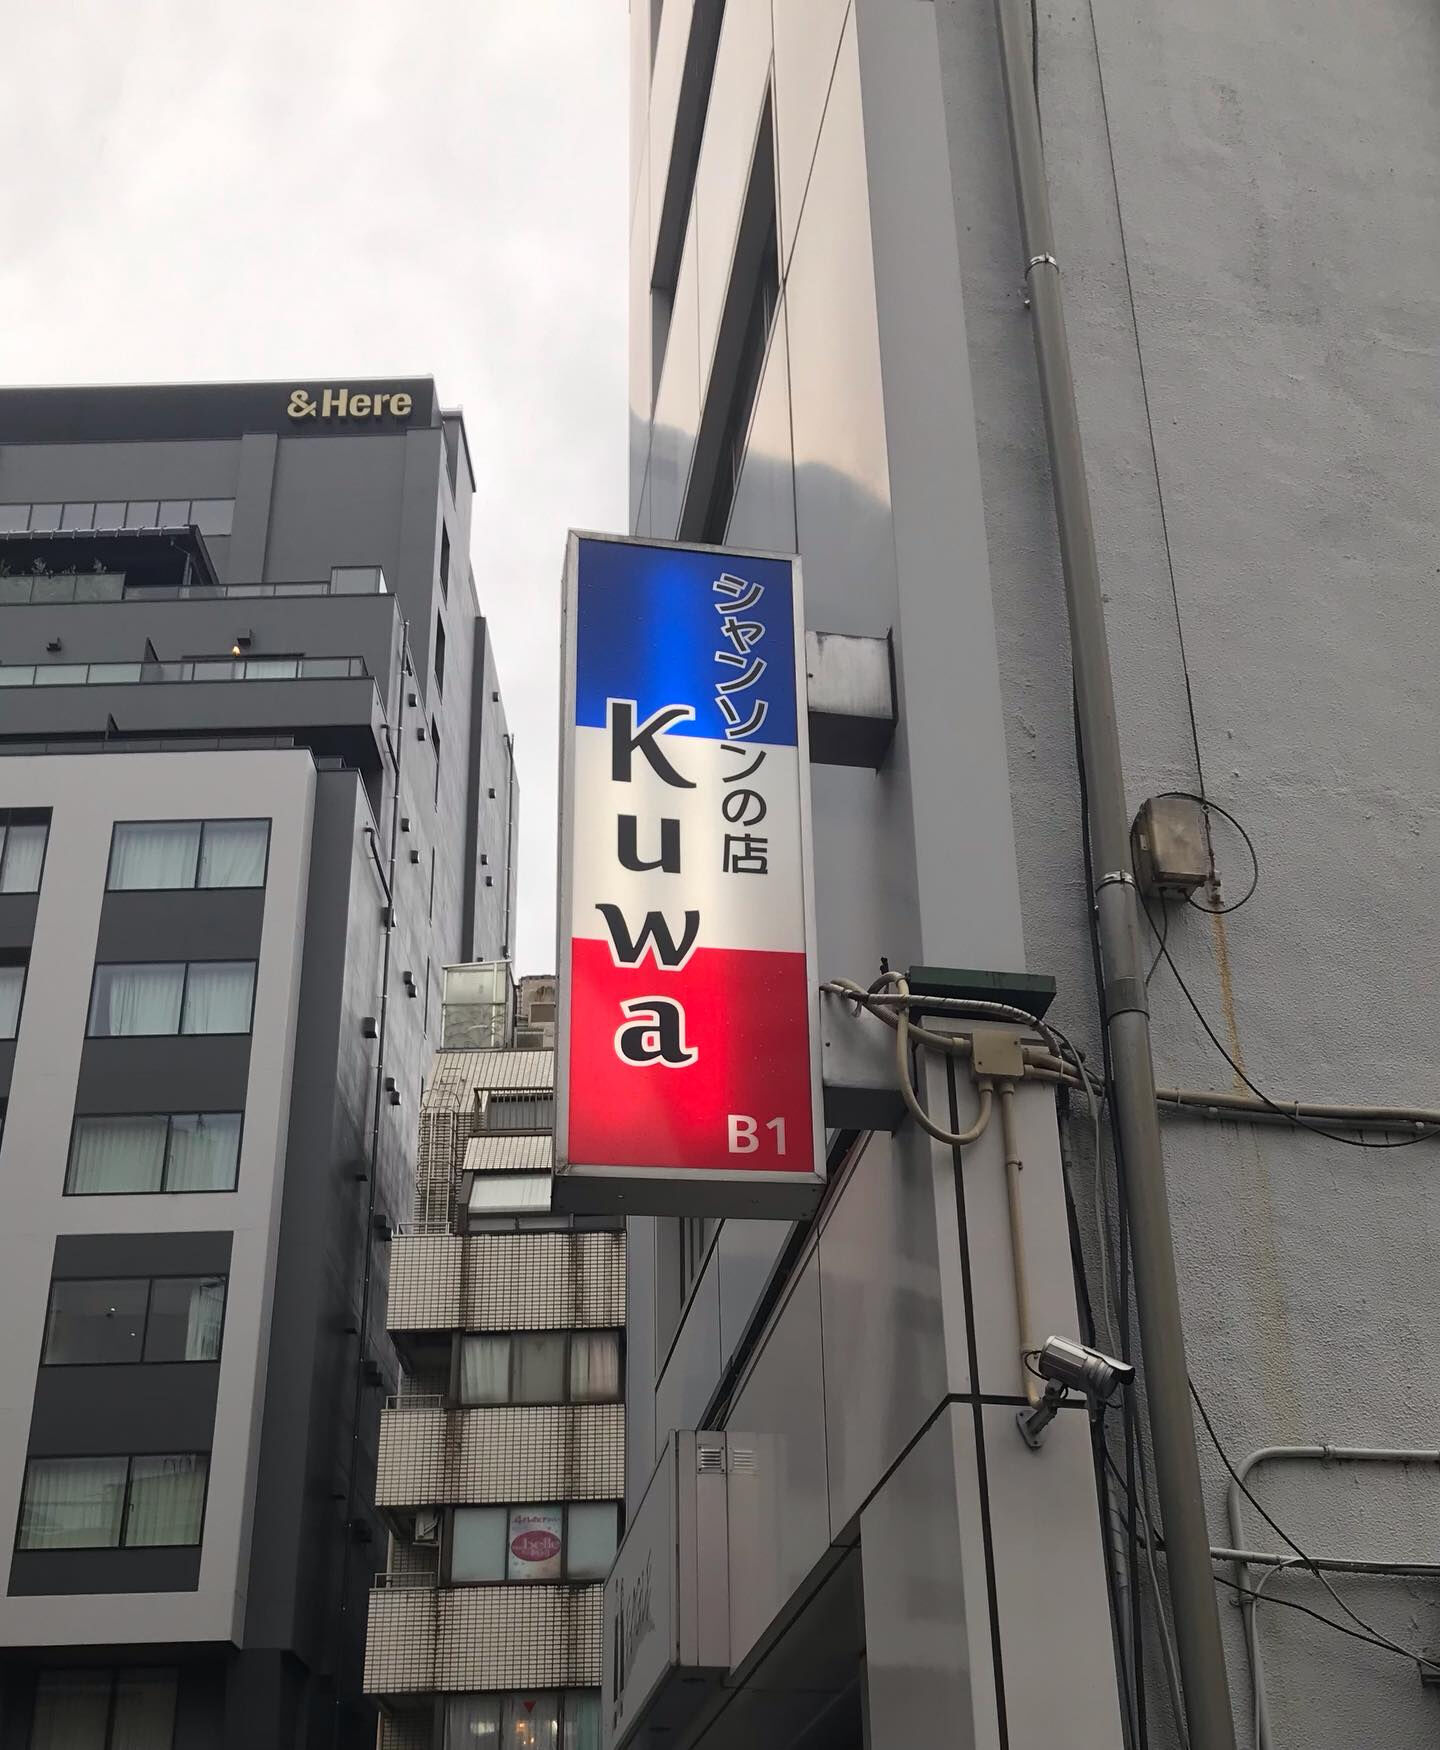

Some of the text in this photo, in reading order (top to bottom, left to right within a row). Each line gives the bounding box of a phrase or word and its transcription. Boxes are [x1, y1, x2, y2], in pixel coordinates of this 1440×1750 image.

[713, 572, 769, 876] シャンソンの店
[595, 699, 700, 1067] Kuwa
[727, 1114, 787, 1156] B1
